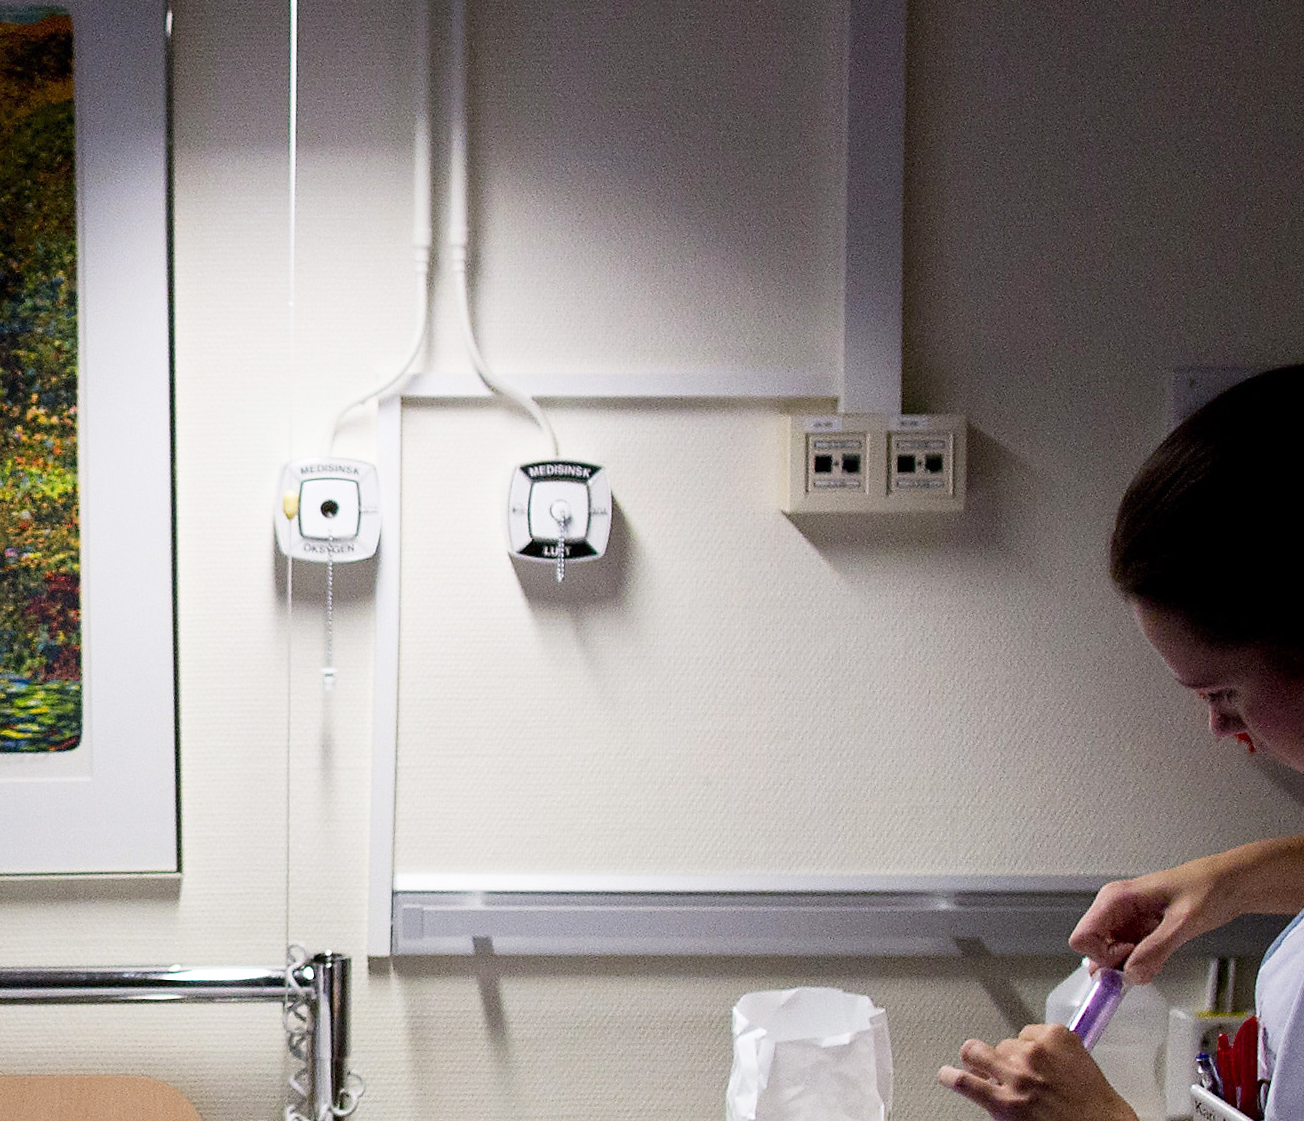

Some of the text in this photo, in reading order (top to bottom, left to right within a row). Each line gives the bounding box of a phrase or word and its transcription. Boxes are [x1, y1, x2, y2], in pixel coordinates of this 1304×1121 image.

[300, 464, 360, 475] MEDISINSK
[528, 464, 591, 477] MEDISINSK
[542, 545, 573, 557] LUT
